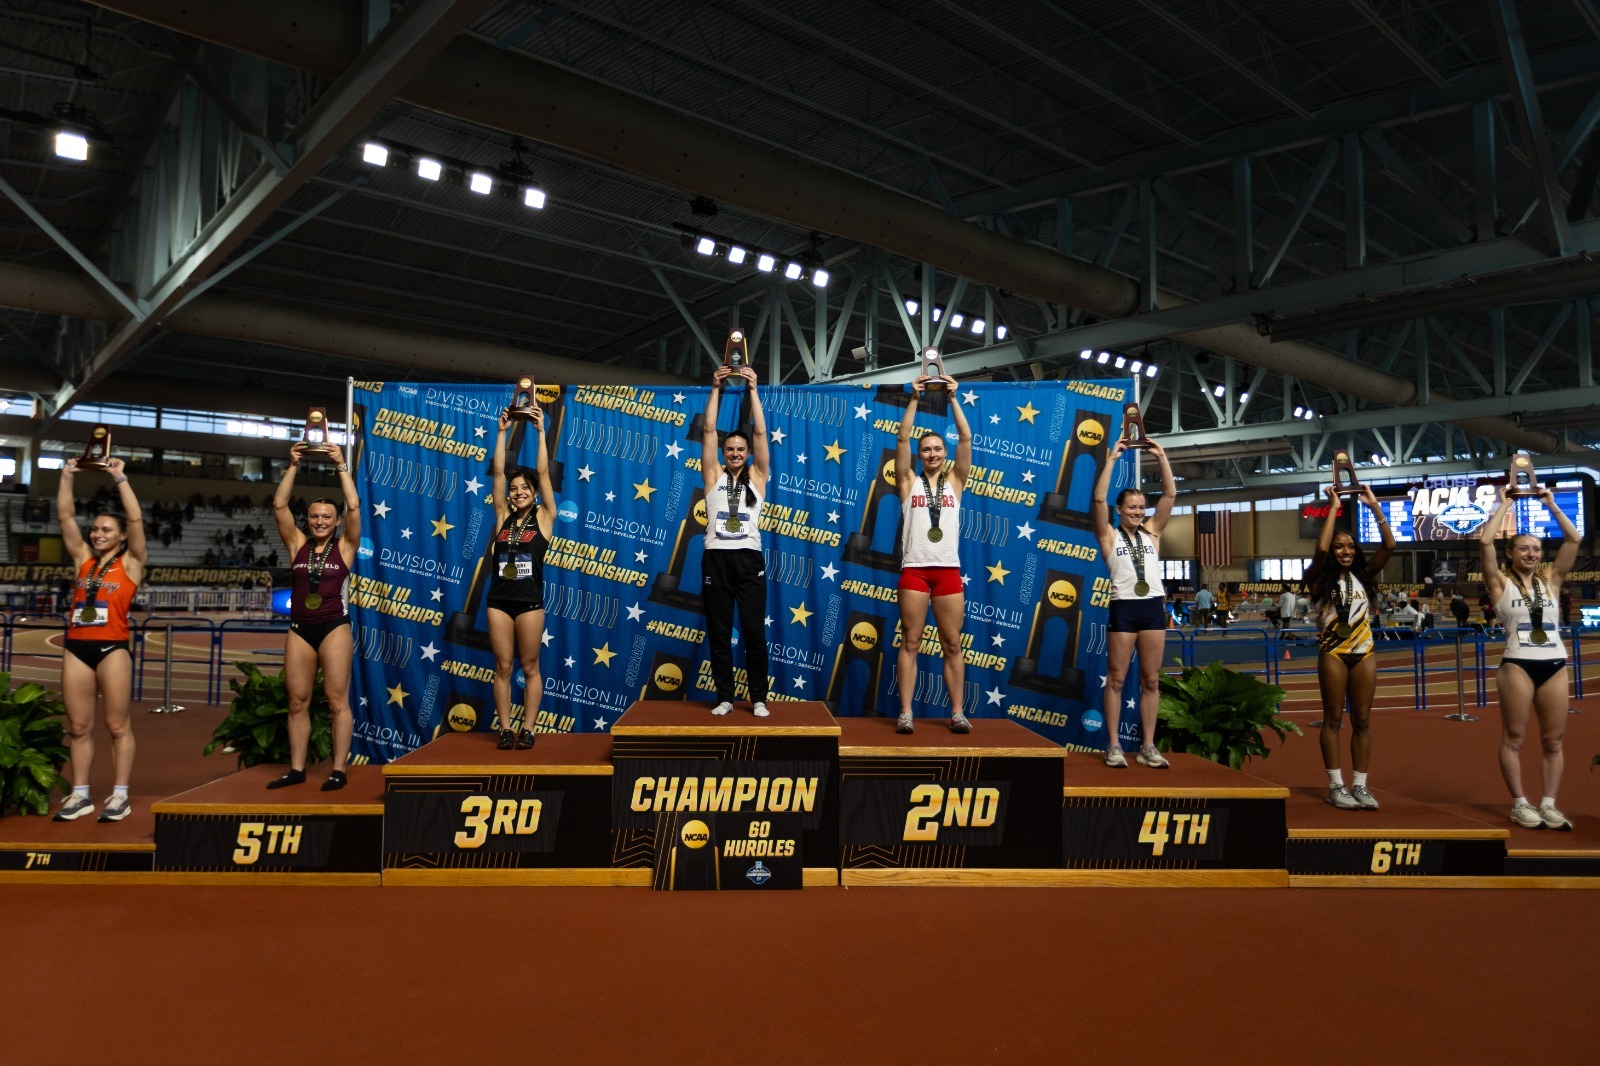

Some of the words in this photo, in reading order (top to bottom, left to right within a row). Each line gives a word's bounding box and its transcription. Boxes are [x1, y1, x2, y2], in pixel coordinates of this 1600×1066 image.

[426, 388, 490, 413] DIVISION
[536, 388, 559, 398] NCAA
[639, 390, 656, 404] III
[1066, 380, 1126, 402] #NCAAD3
[574, 388, 686, 427] CHAMPIONSHIPS
[375, 408, 440, 433] DIVISION
[440, 423, 456, 438] III
[372, 422, 488, 462] CHAMPIONSHIPS
[1079, 430, 1102, 441] NCAA
[972, 446, 996, 456] DISCOVER
[1000, 452, 1022, 460] DEVELOP
[1026, 458, 1050, 466] DEDICATE
[973, 434, 1037, 458] DIVISION
[1041, 449, 1052, 460] III
[780, 472, 842, 496] DIVISION
[846, 488, 858, 500] III
[988, 470, 1004, 484] III
[778, 485, 802, 494] DISCOVER
[806, 492, 828, 500] DEVELOP
[558, 510, 578, 520] NCAA
[793, 509, 809, 525] III
[584, 524, 610, 533] DISCOVER
[614, 530, 636, 540] DEVELOP
[586, 511, 650, 537] DIVISION
[655, 528, 667, 540] III
[758, 516, 842, 548] MPIONSHIPS
[600, 550, 616, 564] III
[1036, 538, 1098, 562] #NCAAD3
[379, 561, 406, 571] DISCOVER
[408, 568, 432, 578] DEVELOP
[436, 575, 460, 584] DEDICATE
[380, 548, 448, 575] DIVISION
[452, 566, 464, 579] III
[544, 550, 648, 588] HAMPIONSHIPS
[392, 586, 411, 602] III
[1050, 592, 1074, 604] NCAA
[349, 589, 444, 626] AMPIONSHIPS
[1012, 611, 1022, 624] III
[646, 620, 706, 644] #NCAAD3
[853, 633, 876, 646] NCAA
[772, 656, 794, 664] DEVELOP
[812, 652, 824, 666] III
[656, 674, 681, 686] NCAA
[544, 690, 568, 700] DISCOVER
[572, 696, 596, 706] DEVELOP
[600, 704, 624, 713] DEDICATE
[545, 678, 610, 704] DIVISION
[615, 694, 628, 707] III
[450, 714, 474, 726] NCAA
[558, 716, 576, 732] III
[1008, 704, 1068, 727] #NCAAD3
[1083, 718, 1102, 728] NCAA
[408, 733, 420, 747] III
[630, 776, 818, 812] CHAMPION
[454, 795, 542, 848] 3RD
[902, 783, 1000, 842] 2ND
[684, 834, 708, 842] NCAA
[748, 820, 771, 838] 60
[1138, 810, 1210, 856] 4TH
[232, 822, 303, 865] 5TH
[724, 840, 796, 857] HURDLES
[25, 852, 51, 869] 7TH
[1370, 841, 1422, 874] 6TH
